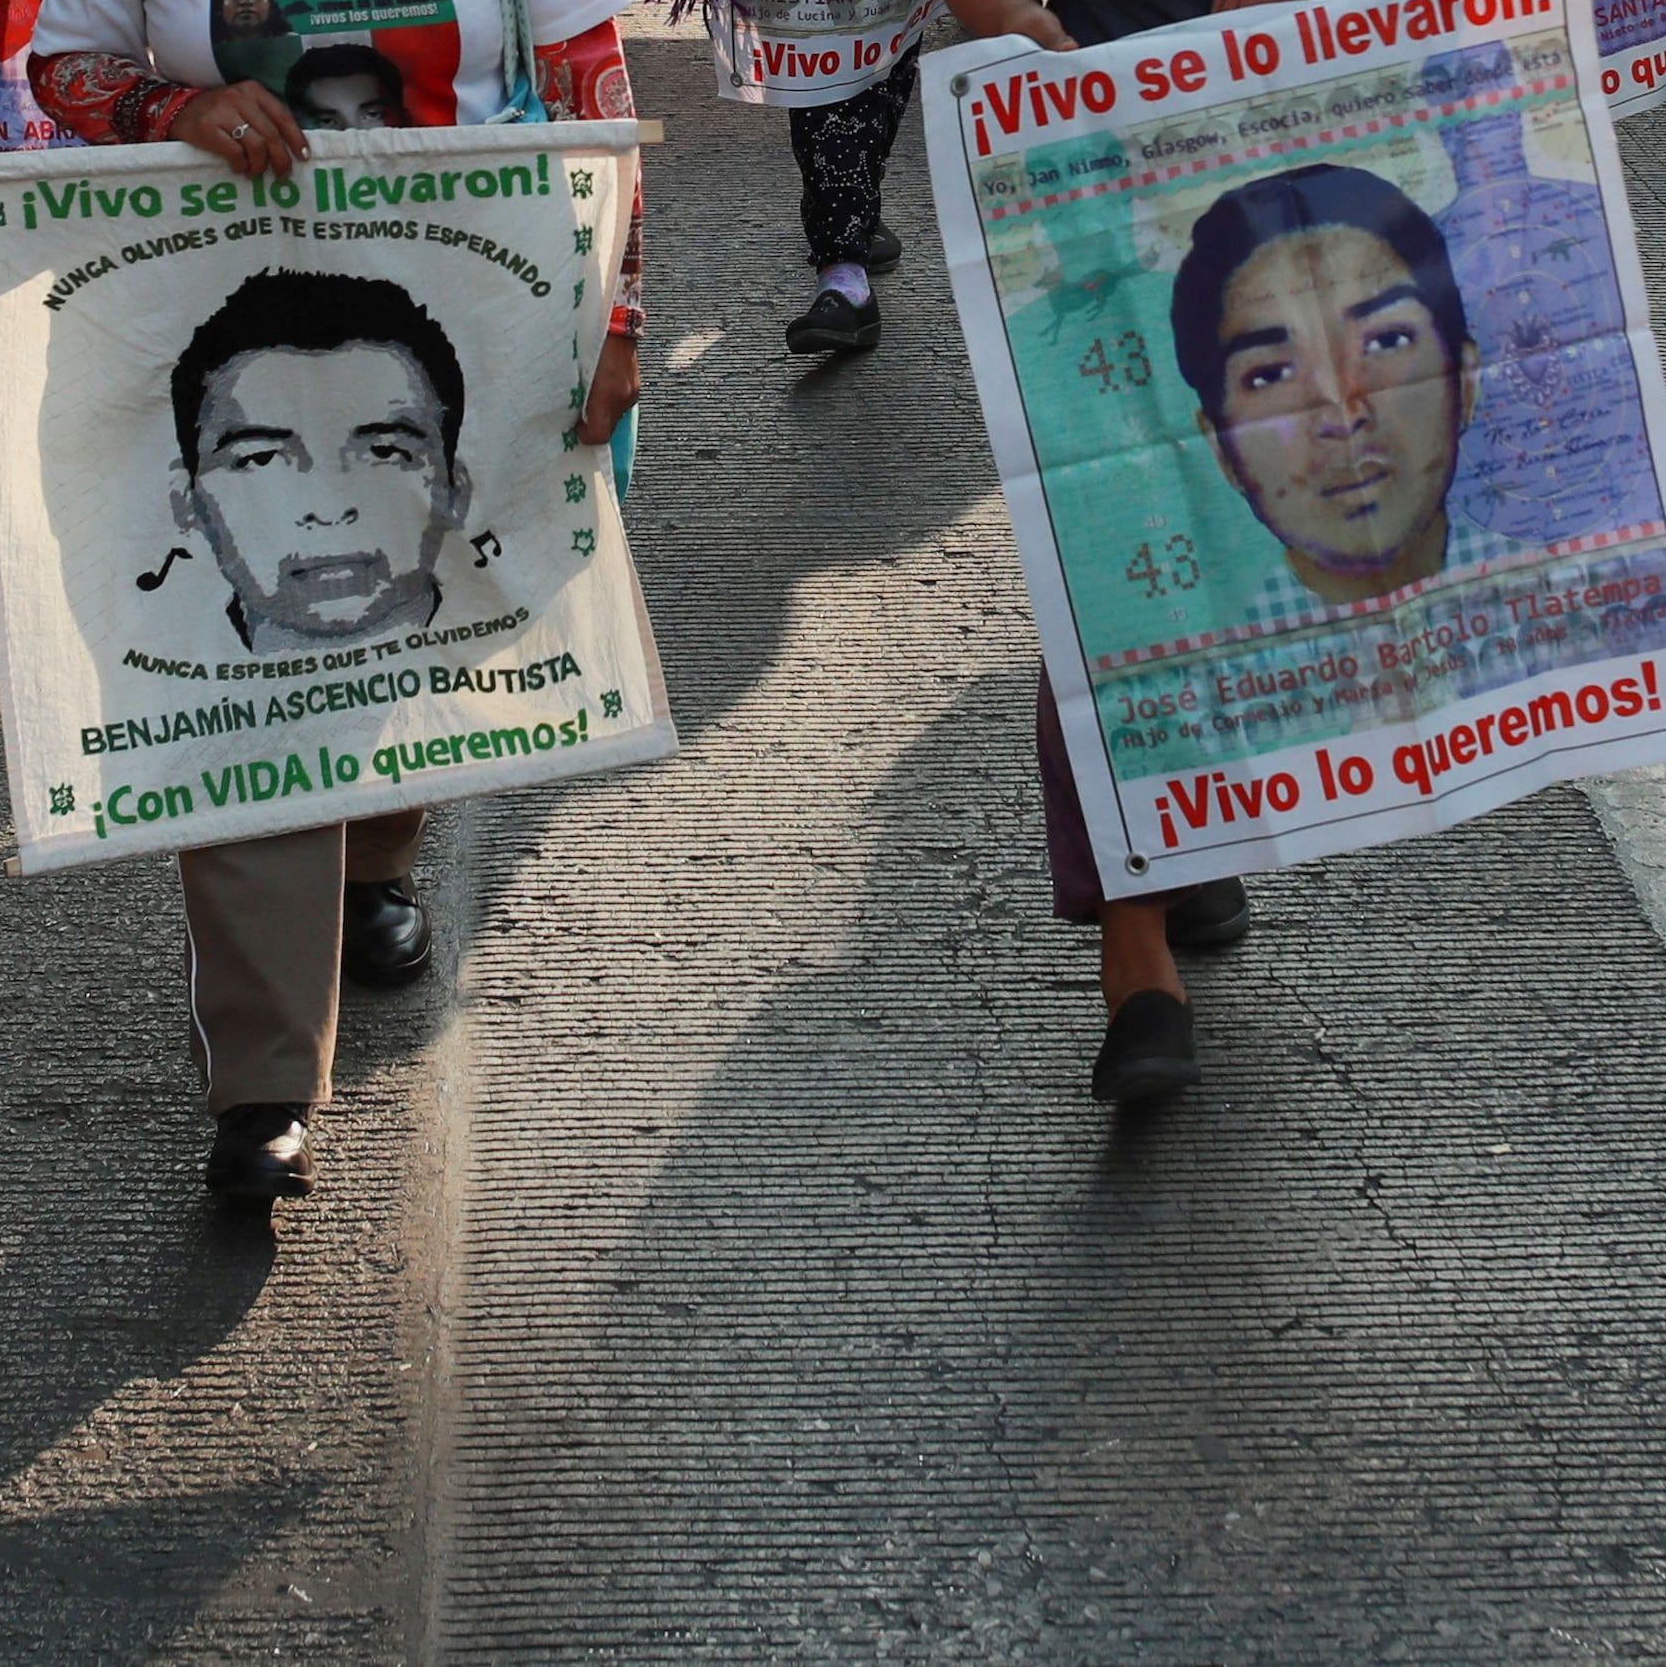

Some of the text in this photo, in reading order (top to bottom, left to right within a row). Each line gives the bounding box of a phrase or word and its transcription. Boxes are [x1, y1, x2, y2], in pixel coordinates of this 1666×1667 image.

[350, 9, 370, 22] los
[371, 3, 439, 22] queremos!
[775, 9, 790, 21] de
[753, 38, 881, 82] ¡Vivo lo
[969, 70, 1118, 157] ¡Vivo
[1134, 48, 1207, 102] se
[1220, 28, 1281, 82] lo
[22, 151, 553, 229] ¡Vivo se llevaron!
[41, 215, 553, 313] NUNCA OLVIDES QUE TE ESTAMOS ESPERANDO
[121, 606, 530, 682] NUNCA ESPERES QUE TE OLVIDEMOS
[80, 650, 583, 756] BENJAMÍN ASCENCIO BAUTISTA
[94, 708, 589, 840] ¡Con VIDA lo queremos!
[1154, 768, 1301, 849] ¡Vivo
[1314, 748, 1375, 803] lo
[1391, 659, 1663, 796] queremos!
